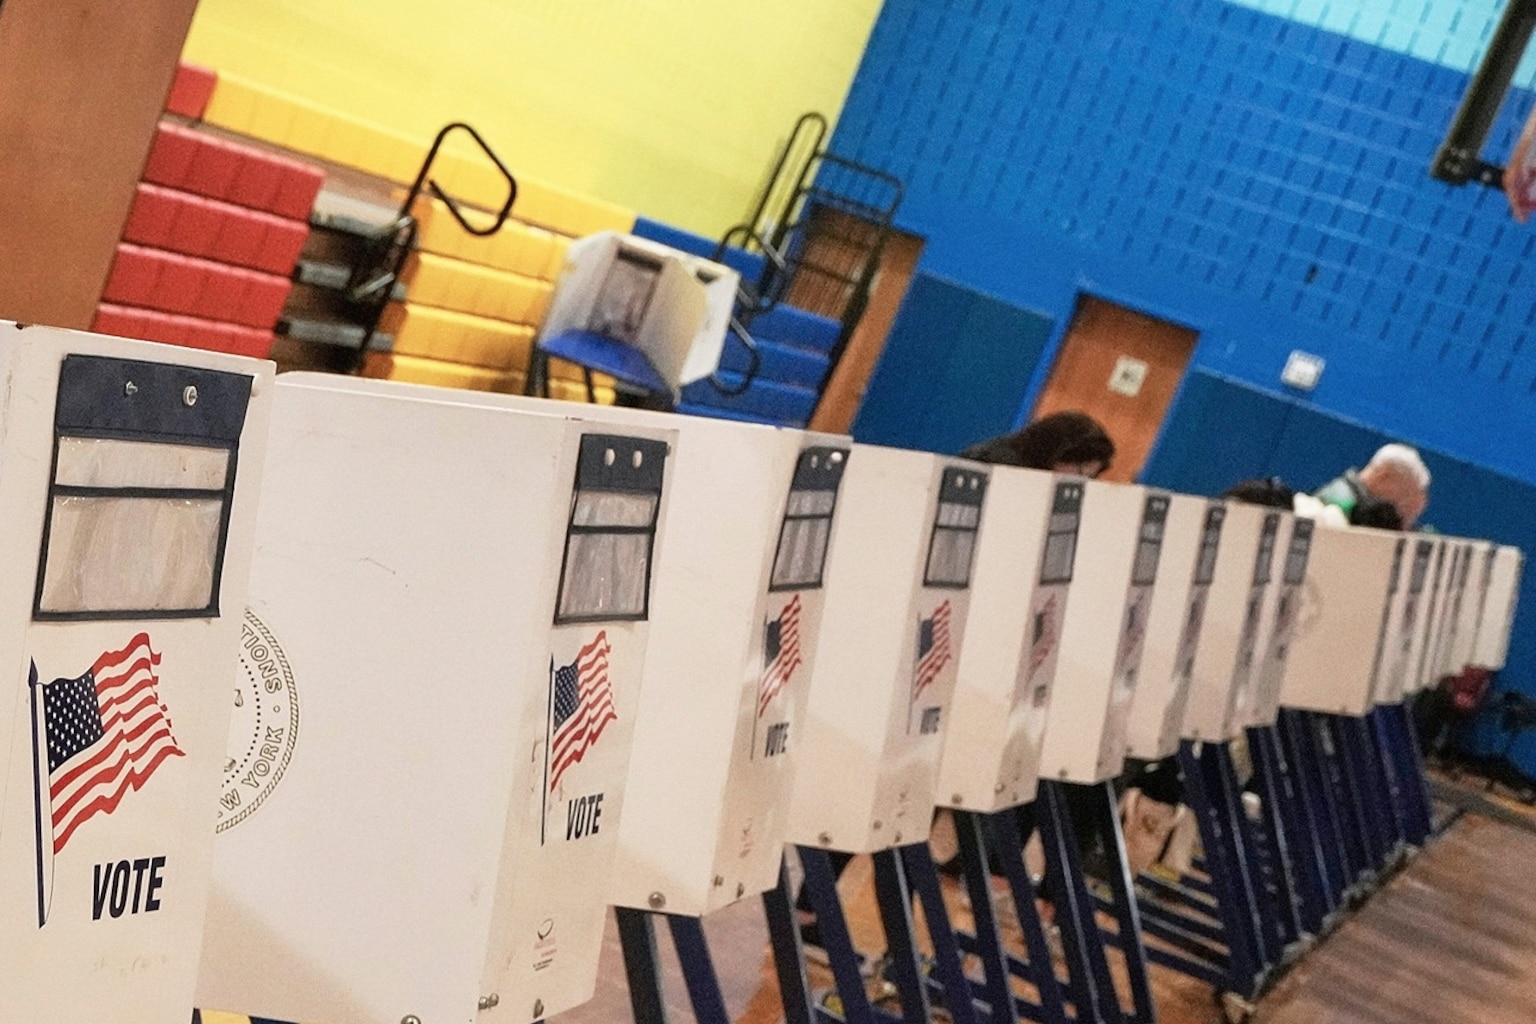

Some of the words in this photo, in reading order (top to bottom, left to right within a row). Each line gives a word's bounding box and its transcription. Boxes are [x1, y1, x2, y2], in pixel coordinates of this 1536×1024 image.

[241, 623, 283, 694] TIONS
[242, 726, 284, 789] YORK
[566, 793, 604, 841] VOTE
[92, 856, 166, 921] VOTE
